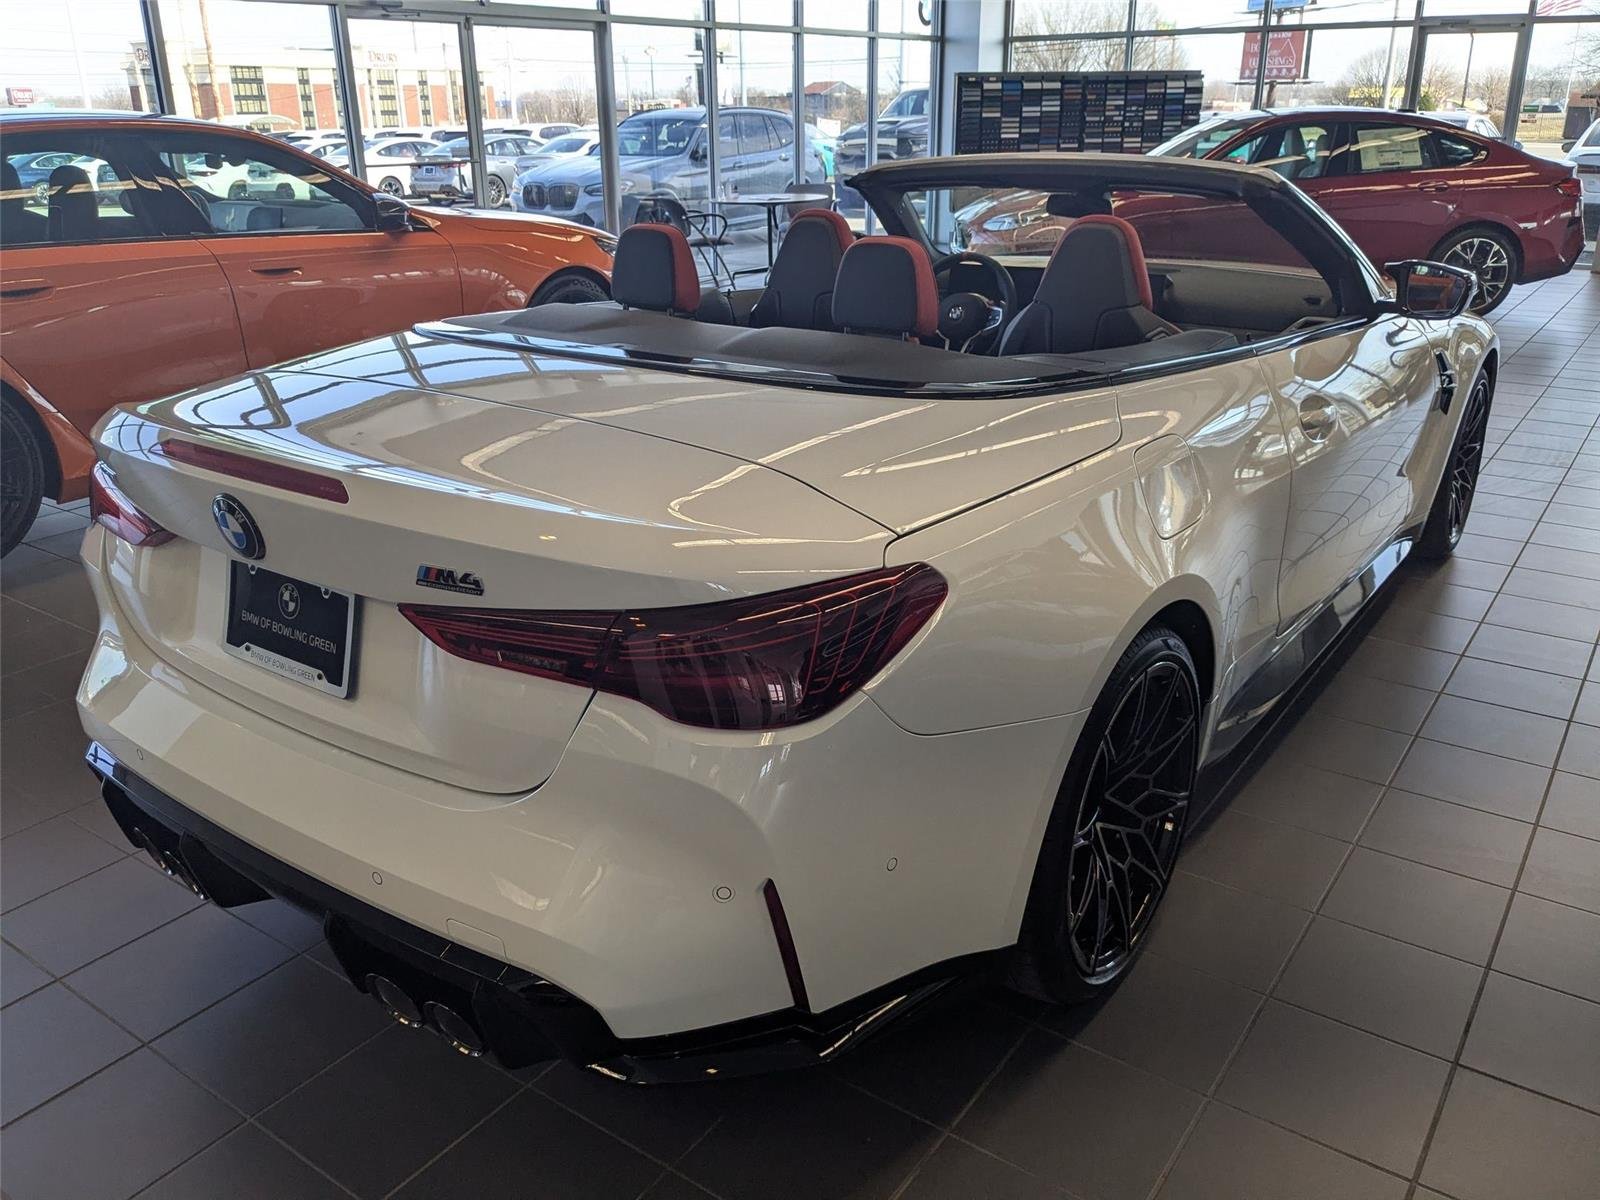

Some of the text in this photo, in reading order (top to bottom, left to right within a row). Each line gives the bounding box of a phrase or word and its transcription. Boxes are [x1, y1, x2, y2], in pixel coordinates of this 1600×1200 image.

[241, 609, 337, 655] BMW OF BOWLING GREEN
[250, 650, 316, 682] BMW OF BOWLING GREEN
